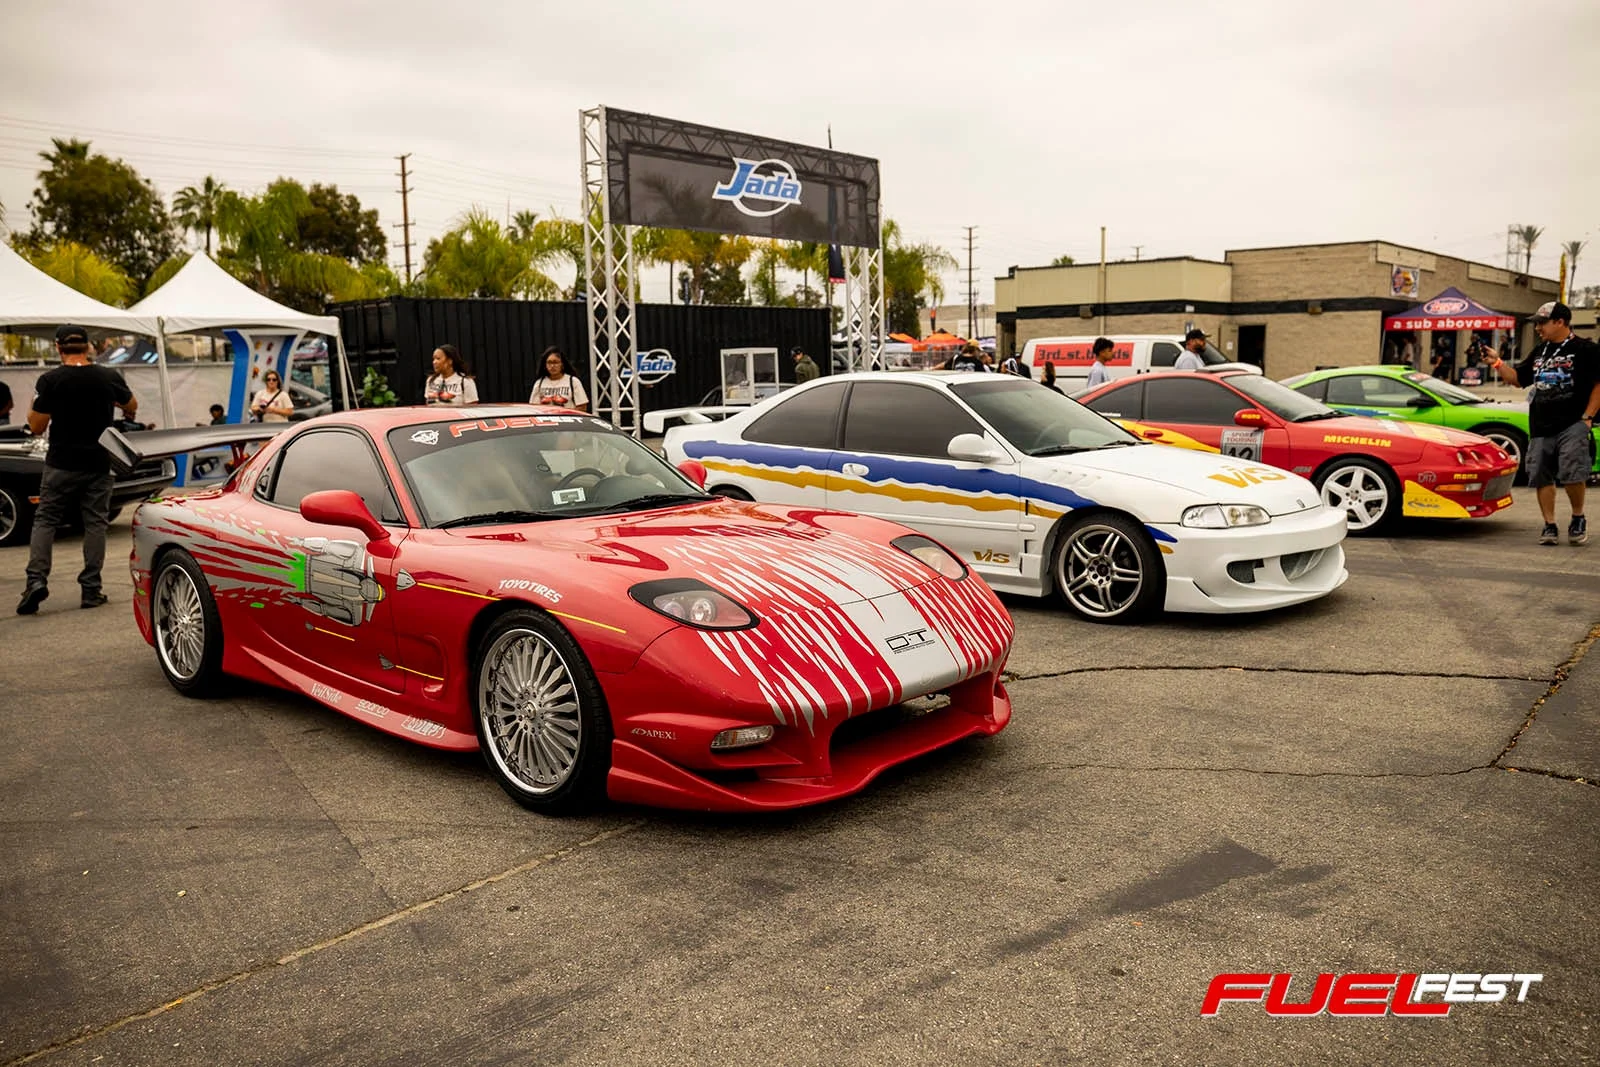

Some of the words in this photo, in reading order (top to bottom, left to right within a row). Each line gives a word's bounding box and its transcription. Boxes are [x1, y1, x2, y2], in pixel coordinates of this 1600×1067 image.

[712, 157, 802, 206] Jada
[1406, 318, 1432, 329] sub
[1437, 318, 1482, 328] above
[1323, 434, 1392, 448] MICHELIN
[498, 579, 531, 590] TOYO
[528, 582, 564, 603] TIRES
